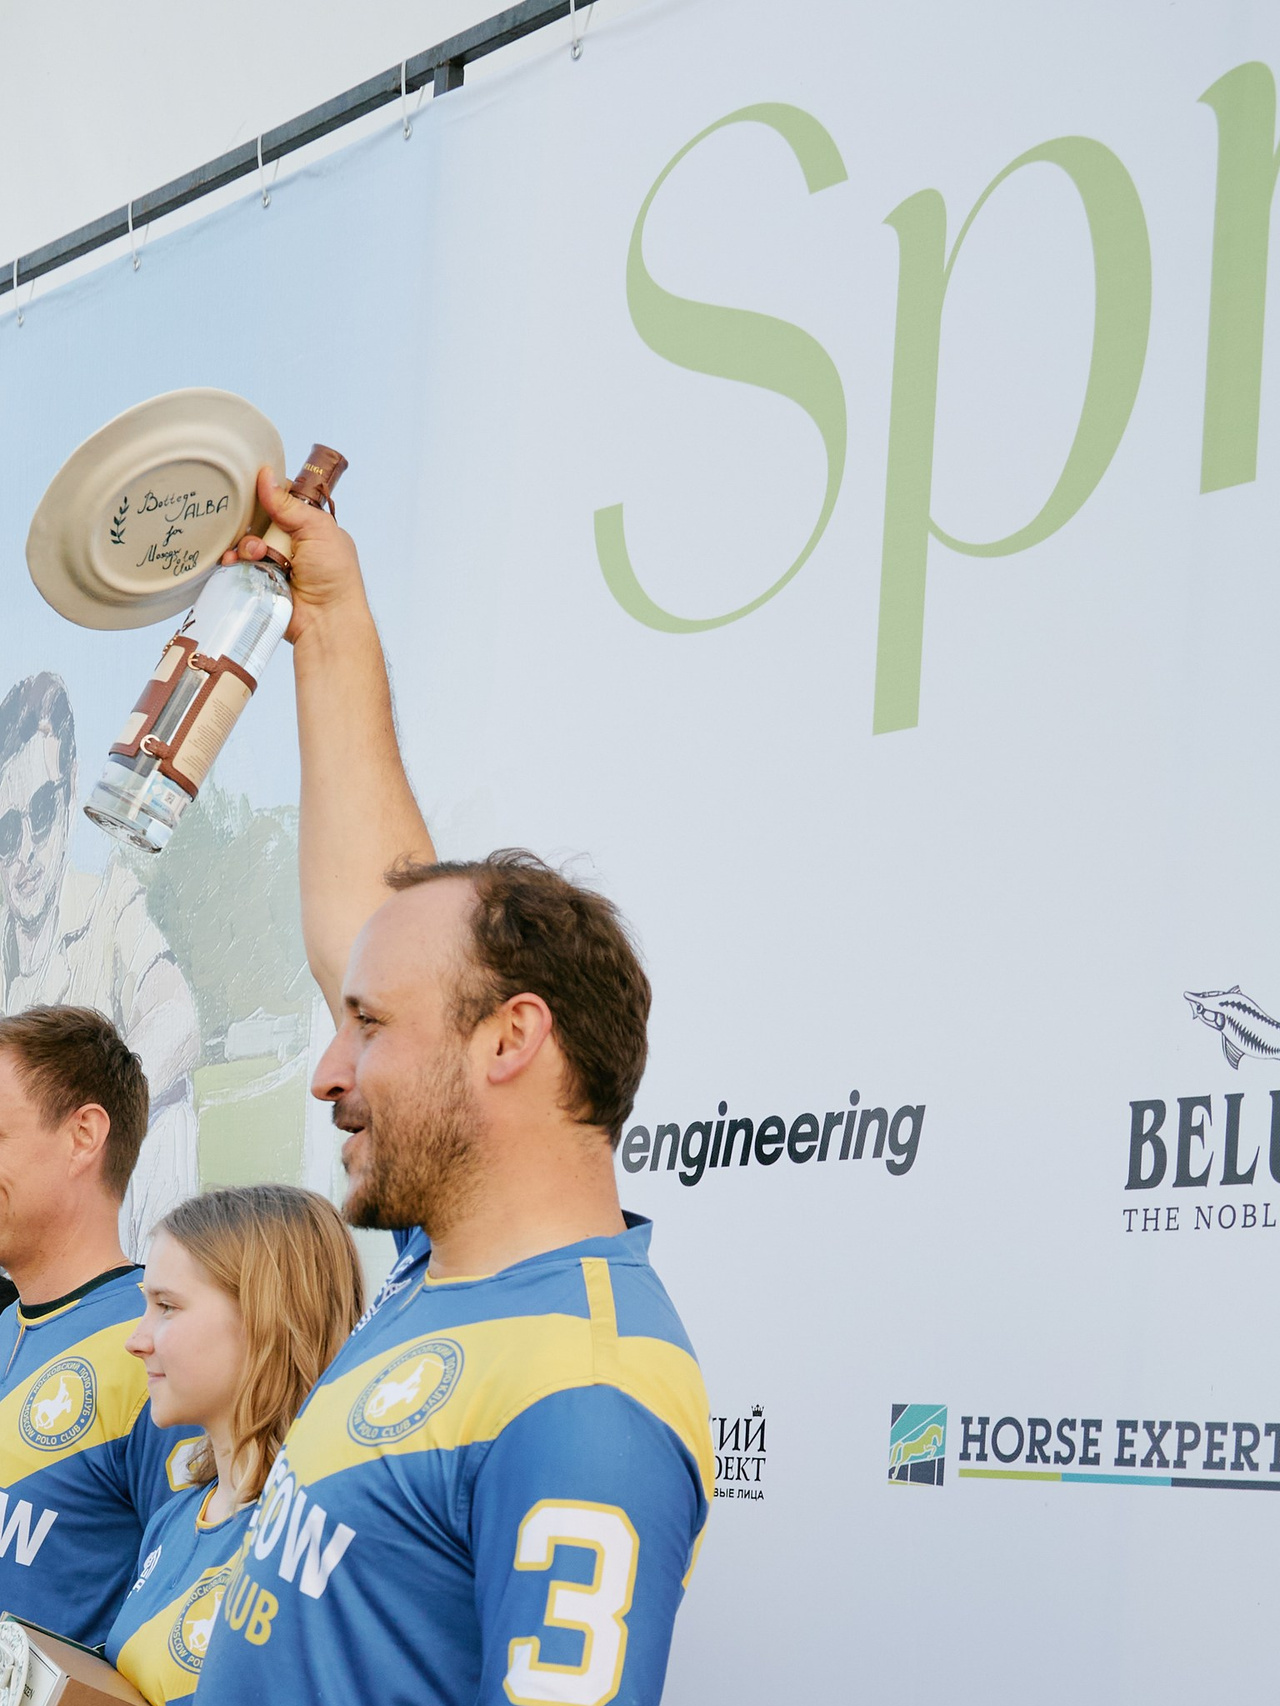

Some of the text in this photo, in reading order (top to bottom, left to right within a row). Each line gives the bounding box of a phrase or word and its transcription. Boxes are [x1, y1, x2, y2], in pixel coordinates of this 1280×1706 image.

[137, 490, 196, 522] Bottega
[184, 496, 229, 520] ALBA
[162, 525, 184, 547] for
[621, 1089, 926, 1187] engineering
[1123, 1203, 1277, 1232] THE NOBL
[80, 1367, 92, 1389] ПОЛО
[82, 1390, 93, 1416] КЛУБ
[35, 1434, 57, 1444] POLO
[60, 1424, 81, 1442] CLUB
[357, 1423, 379, 1438] POLO
[381, 1419, 412, 1437] CLUB
[712, 1405, 766, 1452] ИЙ
[958, 1416, 1103, 1466] HORSE
[737, 1489, 764, 1501] ЛИЦА
[172, 1617, 188, 1658] MOSCOW
